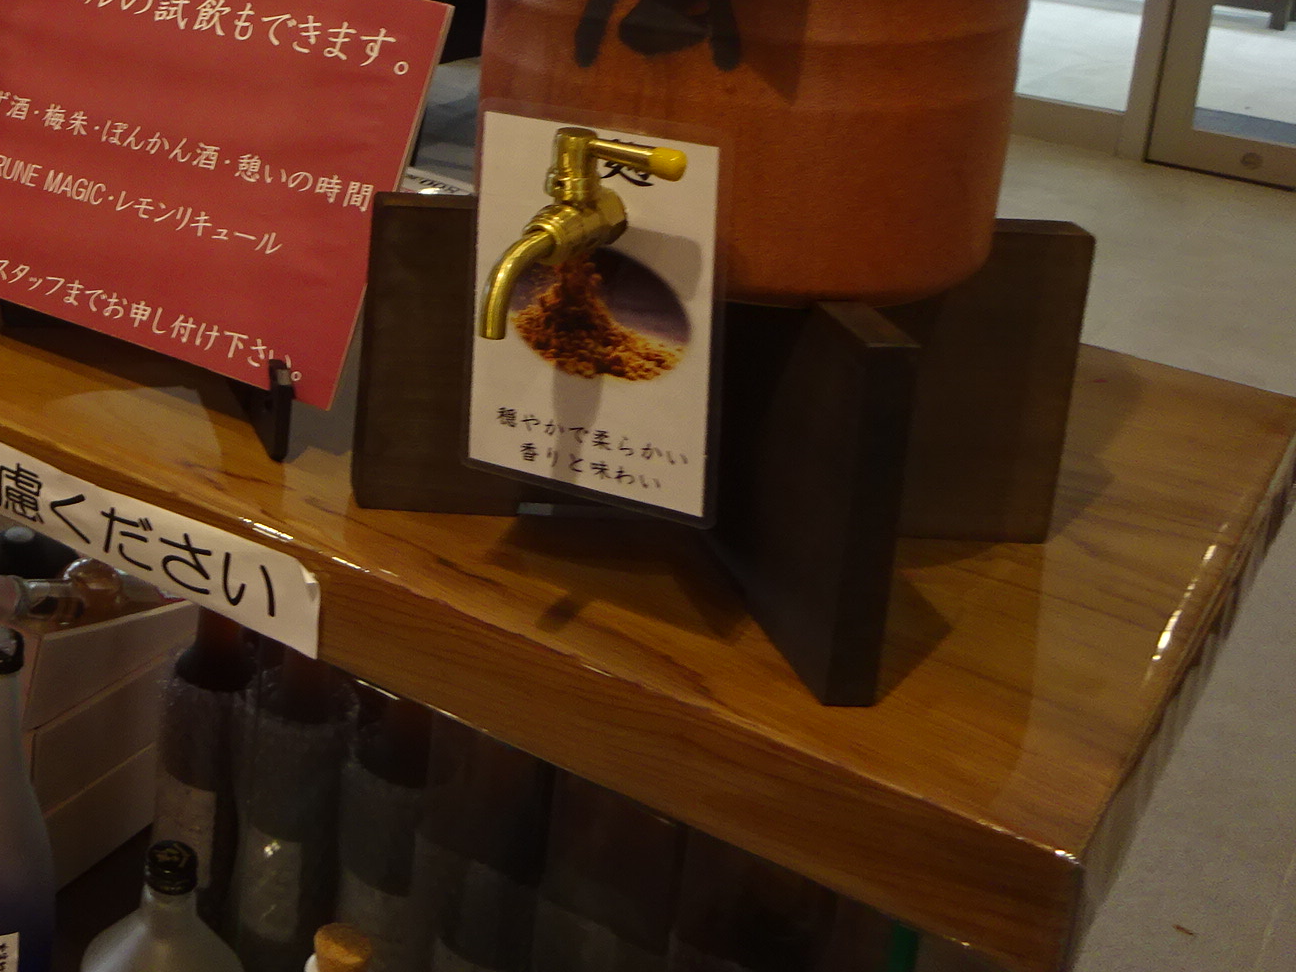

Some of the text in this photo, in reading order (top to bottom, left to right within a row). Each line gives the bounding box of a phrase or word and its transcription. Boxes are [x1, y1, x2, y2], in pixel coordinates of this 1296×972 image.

[495, 405, 689, 465] 穏やかで柔らかい
[519, 441, 662, 489] 香りと味わい
